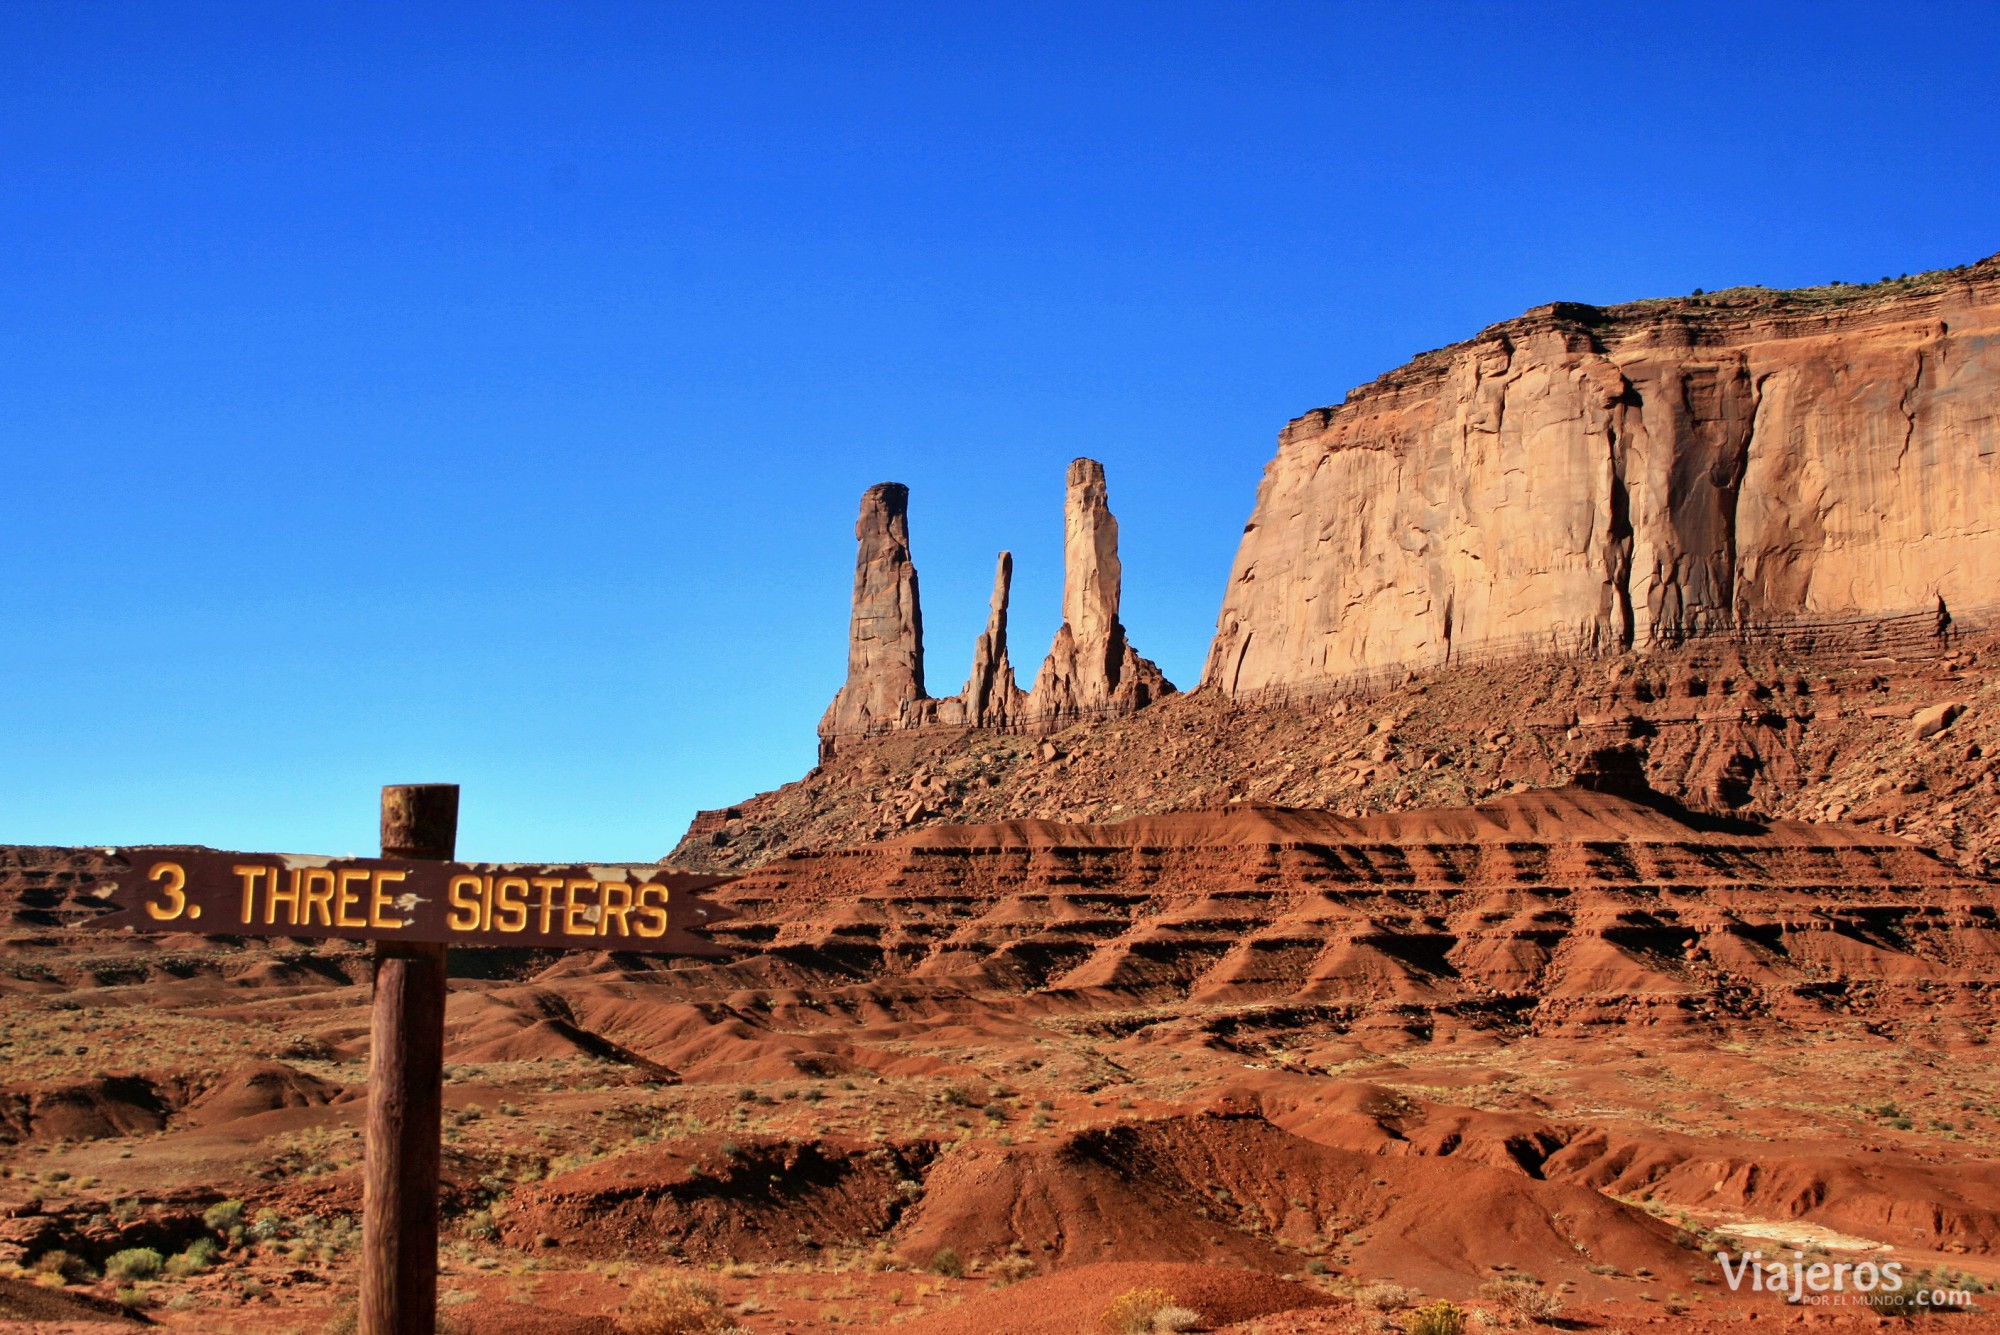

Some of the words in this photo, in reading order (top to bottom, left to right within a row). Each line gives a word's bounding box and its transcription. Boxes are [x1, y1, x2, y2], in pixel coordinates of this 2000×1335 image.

[145, 861, 202, 921] 3.
[233, 864, 407, 929] THREE
[447, 873, 669, 938] SISTERS
